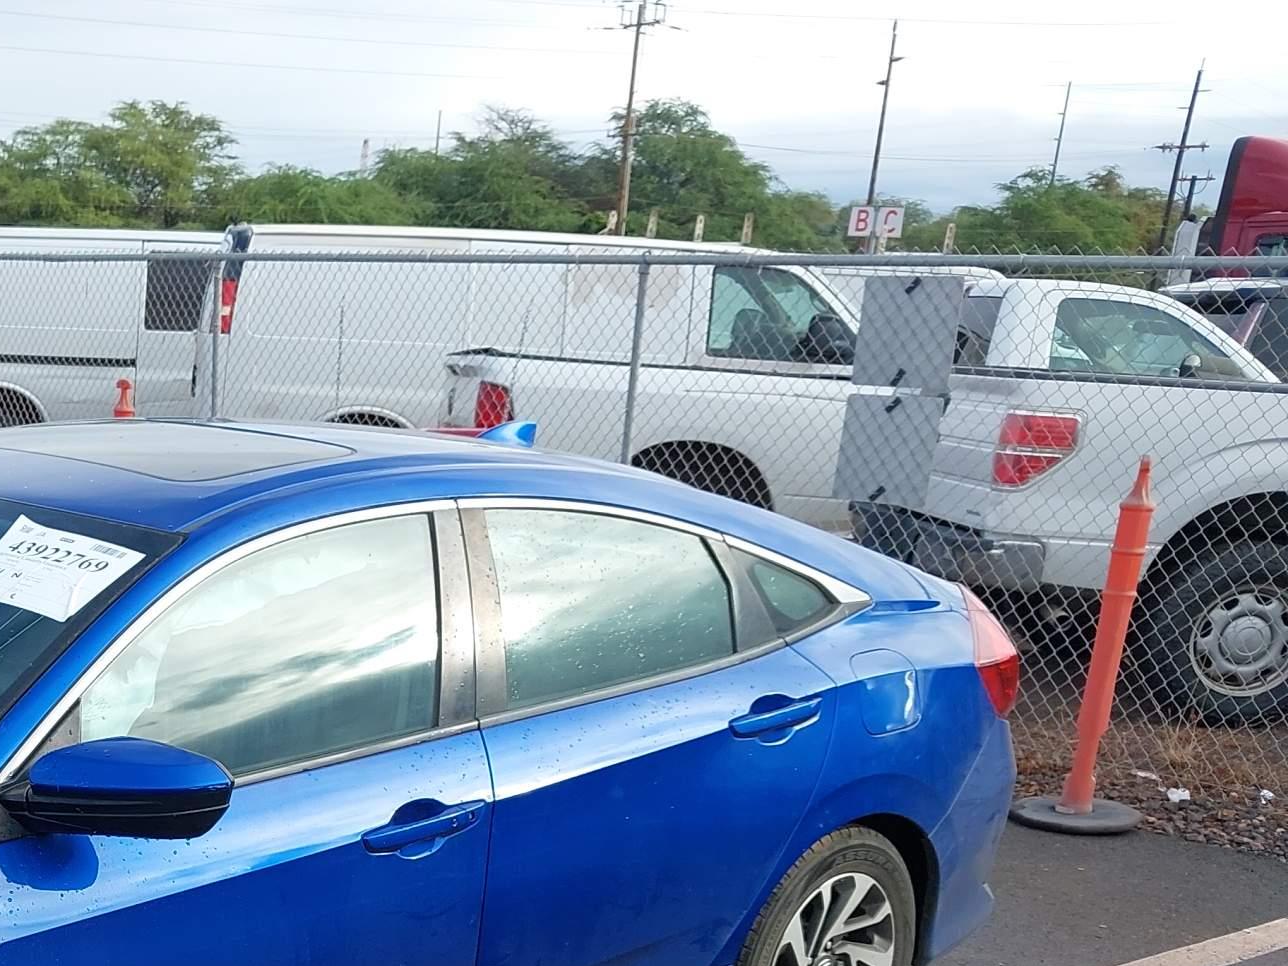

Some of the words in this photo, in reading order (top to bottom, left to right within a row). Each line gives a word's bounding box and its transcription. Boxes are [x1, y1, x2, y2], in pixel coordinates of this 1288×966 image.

[855, 209, 869, 232] B
[884, 210, 898, 233] C
[8, 540, 110, 573] 43922769
